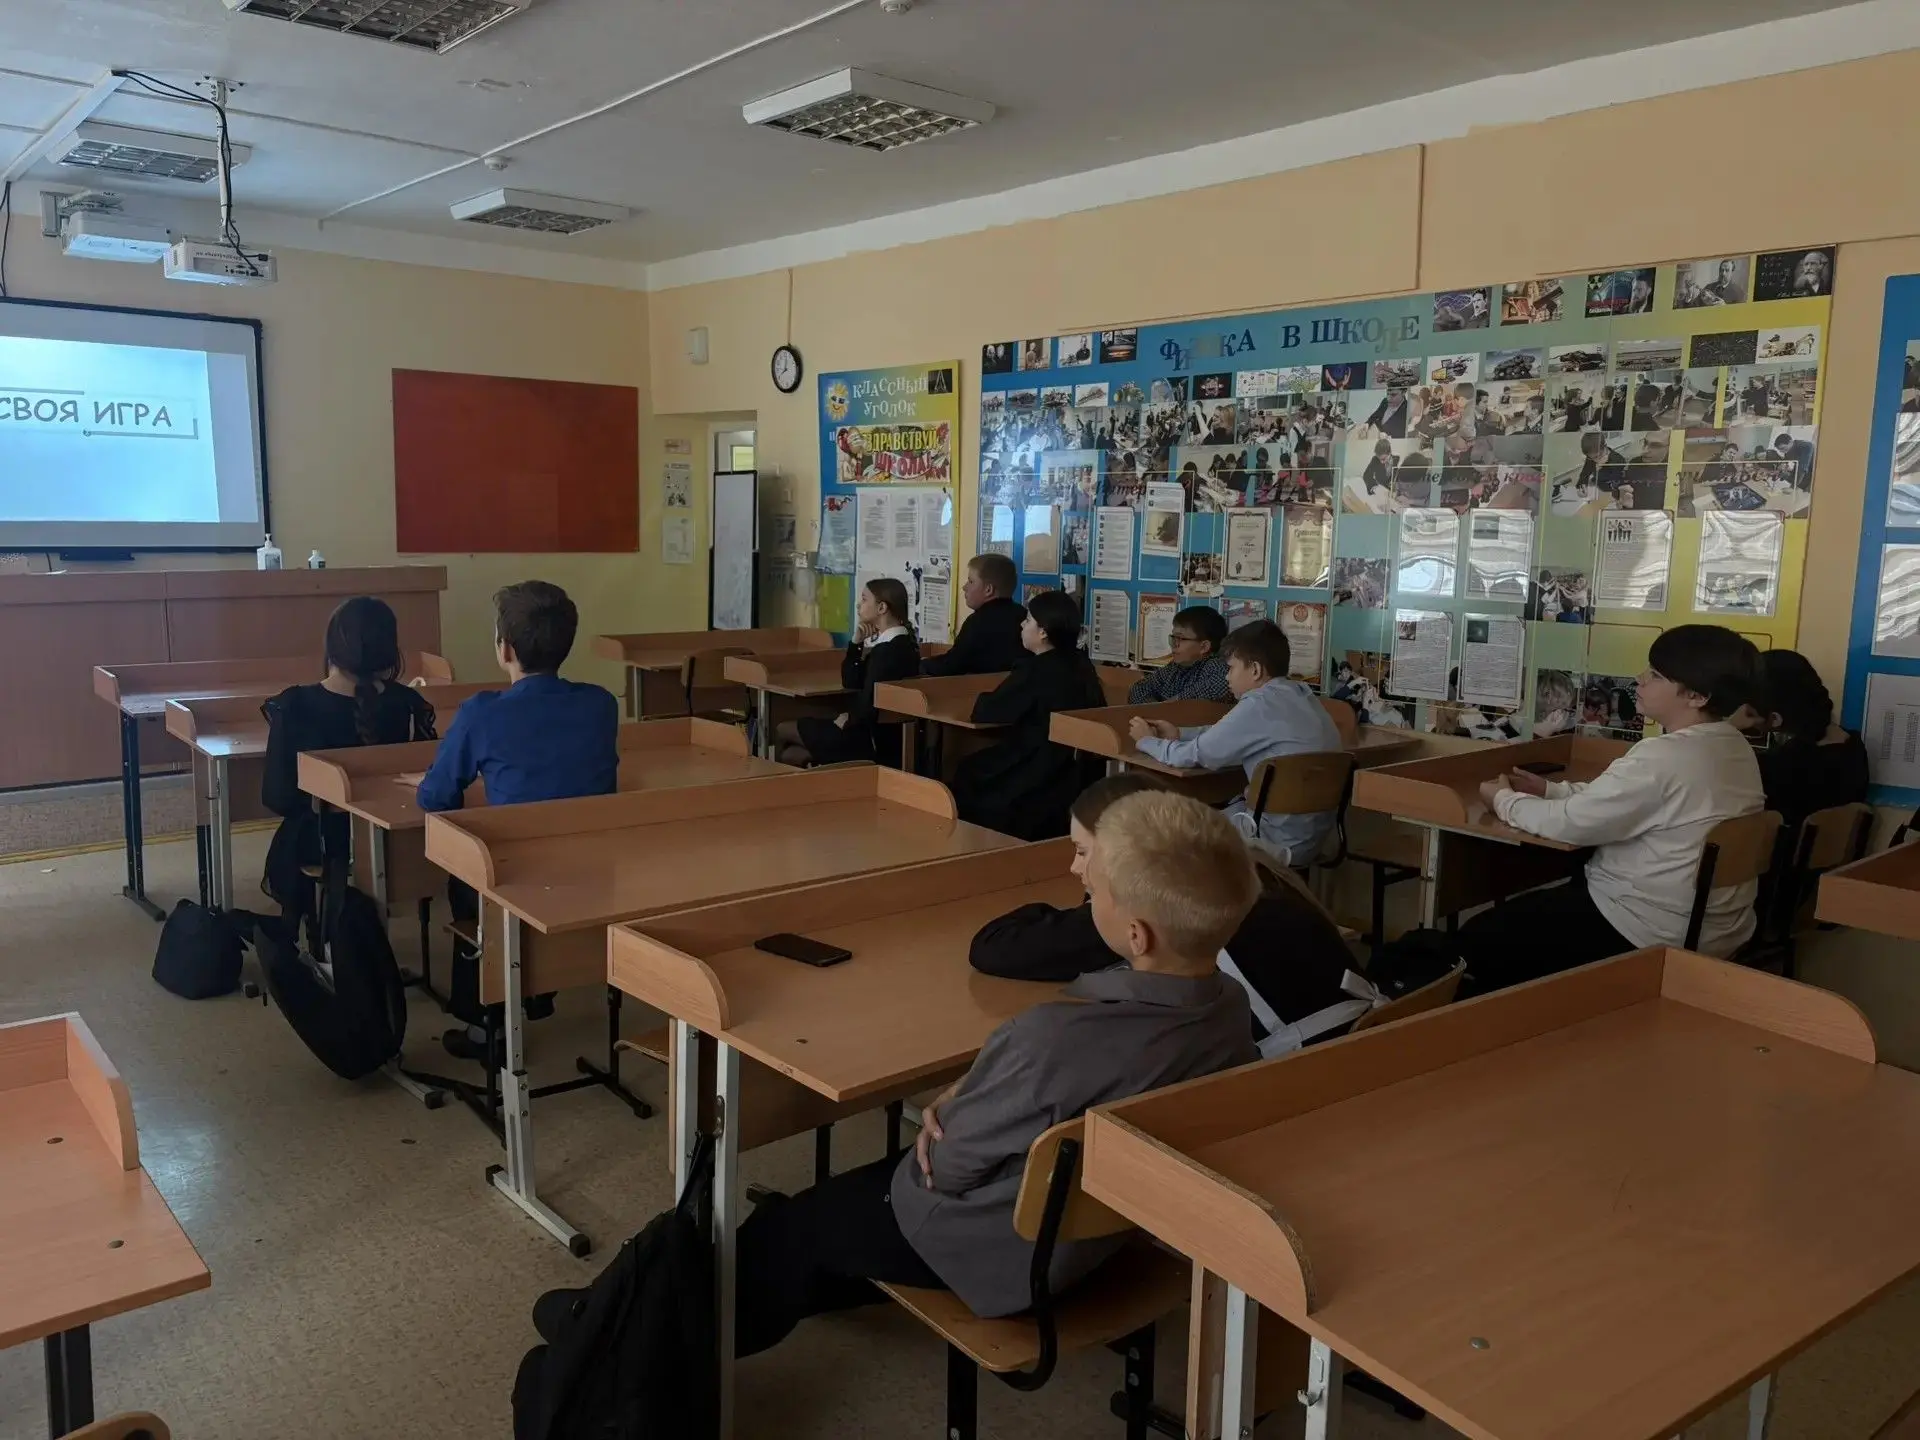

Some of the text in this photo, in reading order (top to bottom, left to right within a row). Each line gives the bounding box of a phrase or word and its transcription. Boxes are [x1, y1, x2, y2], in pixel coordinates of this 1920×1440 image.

[1280, 324, 1301, 348] В
[1309, 315, 1420, 354] ШКОЛЕ
[94, 401, 172, 427] ИГРА
[864, 399, 916, 418] УГОЛОК
